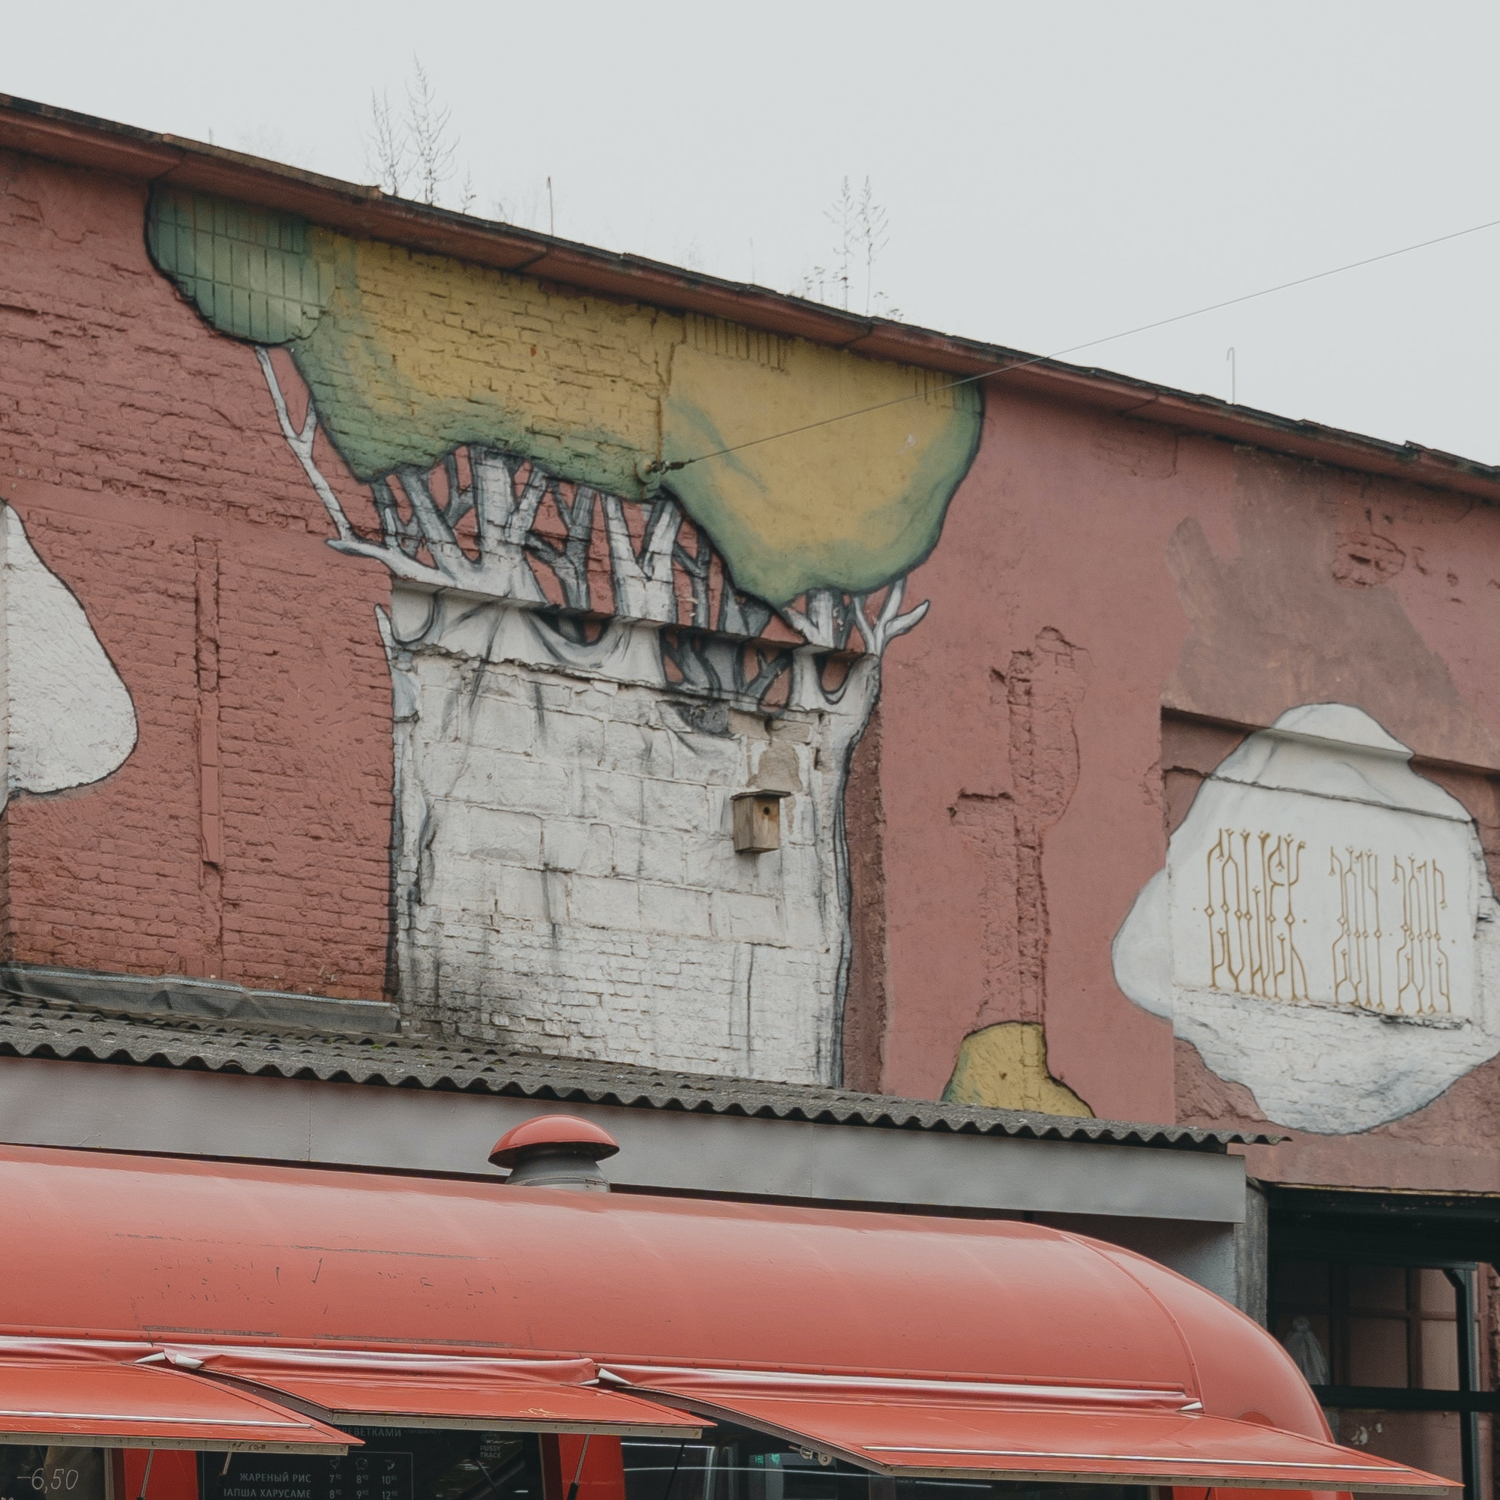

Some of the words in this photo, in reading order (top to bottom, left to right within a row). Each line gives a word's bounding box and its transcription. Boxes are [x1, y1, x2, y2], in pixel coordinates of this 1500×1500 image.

[239, 1471, 290, 1483] ЖАРЕНЫЙ
[292, 1474, 312, 1484] РИС
[259, 1489, 312, 1499] ХАРУСАМЕ
